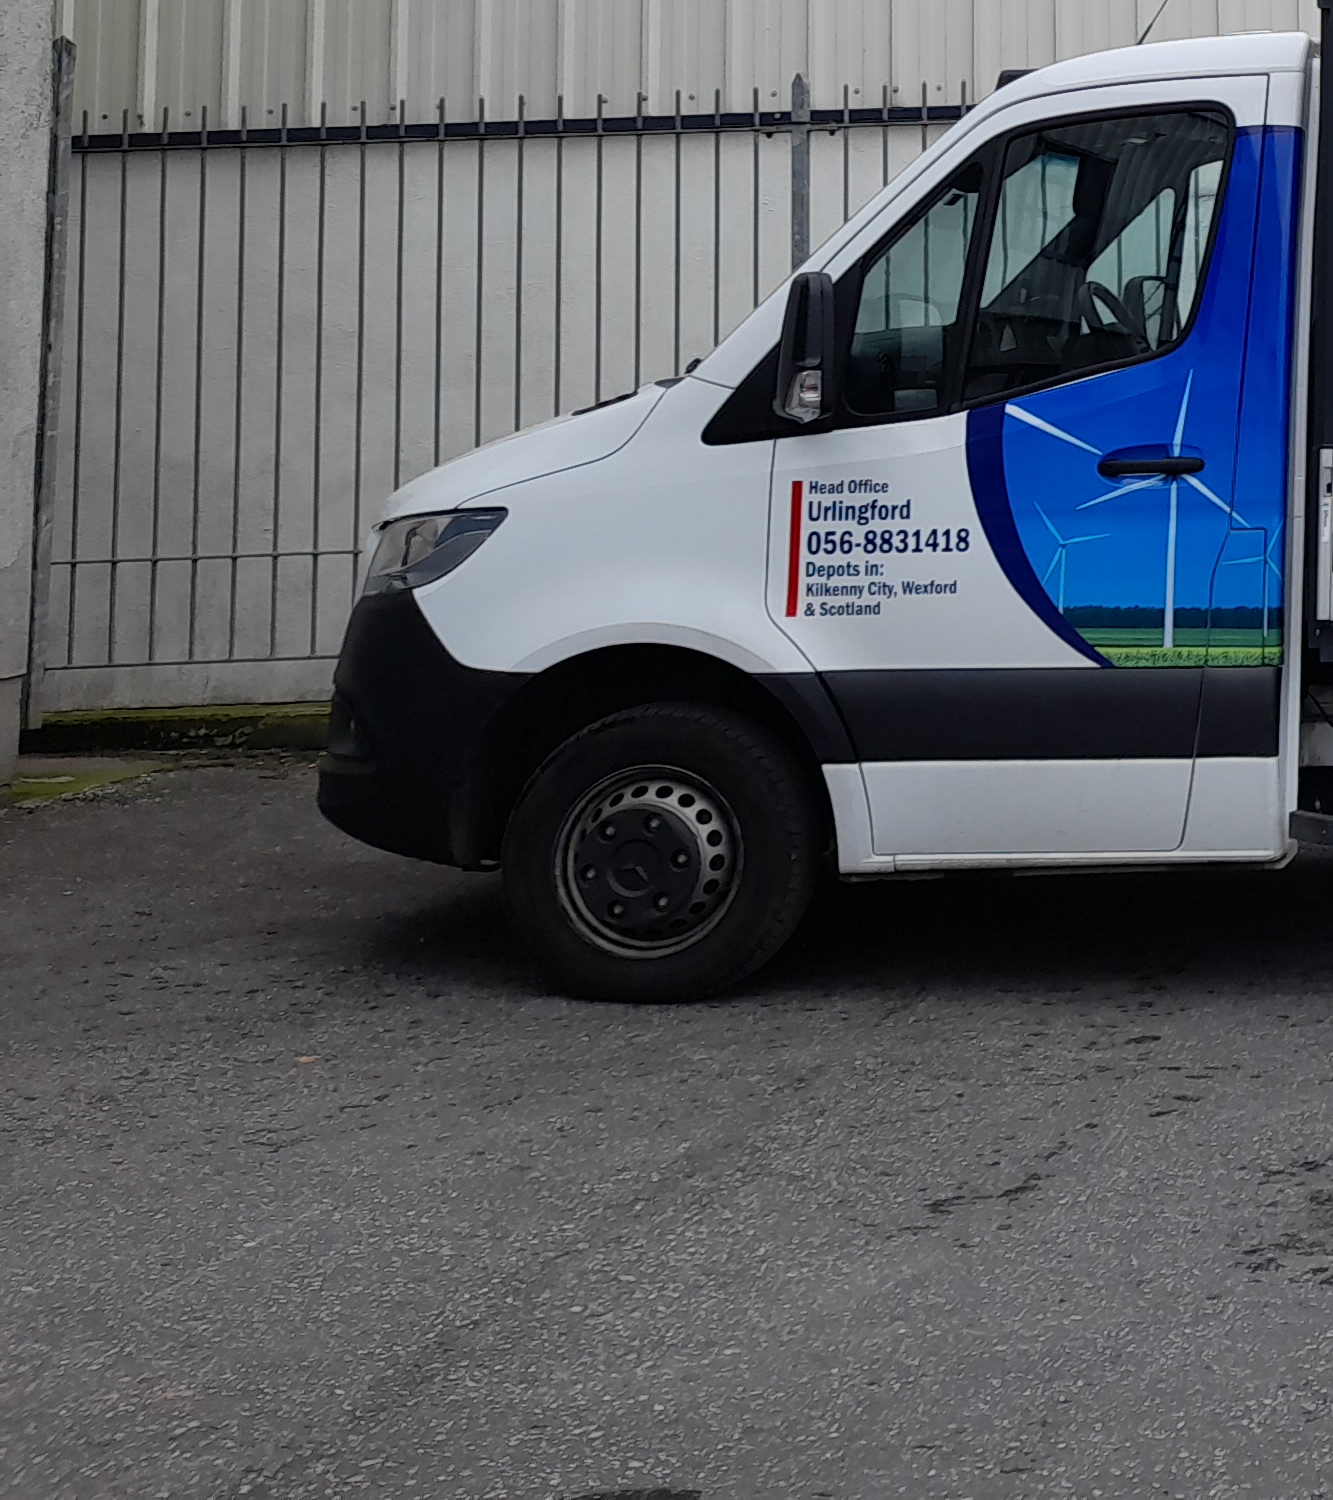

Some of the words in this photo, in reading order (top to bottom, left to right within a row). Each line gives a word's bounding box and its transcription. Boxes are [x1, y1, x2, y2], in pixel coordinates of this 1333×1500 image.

[808, 480, 845, 495] Head
[847, 479, 889, 494] Office
[807, 499, 911, 525] Urlingford
[806, 528, 970, 555] 056-8831418
[805, 561, 860, 580] Depots
[864, 560, 884, 577] in:
[805, 582, 865, 599] Kilkenny
[867, 581, 898, 598] City,
[901, 579, 957, 596] Wexford
[804, 603, 815, 617] &
[819, 601, 881, 617] Scotland
